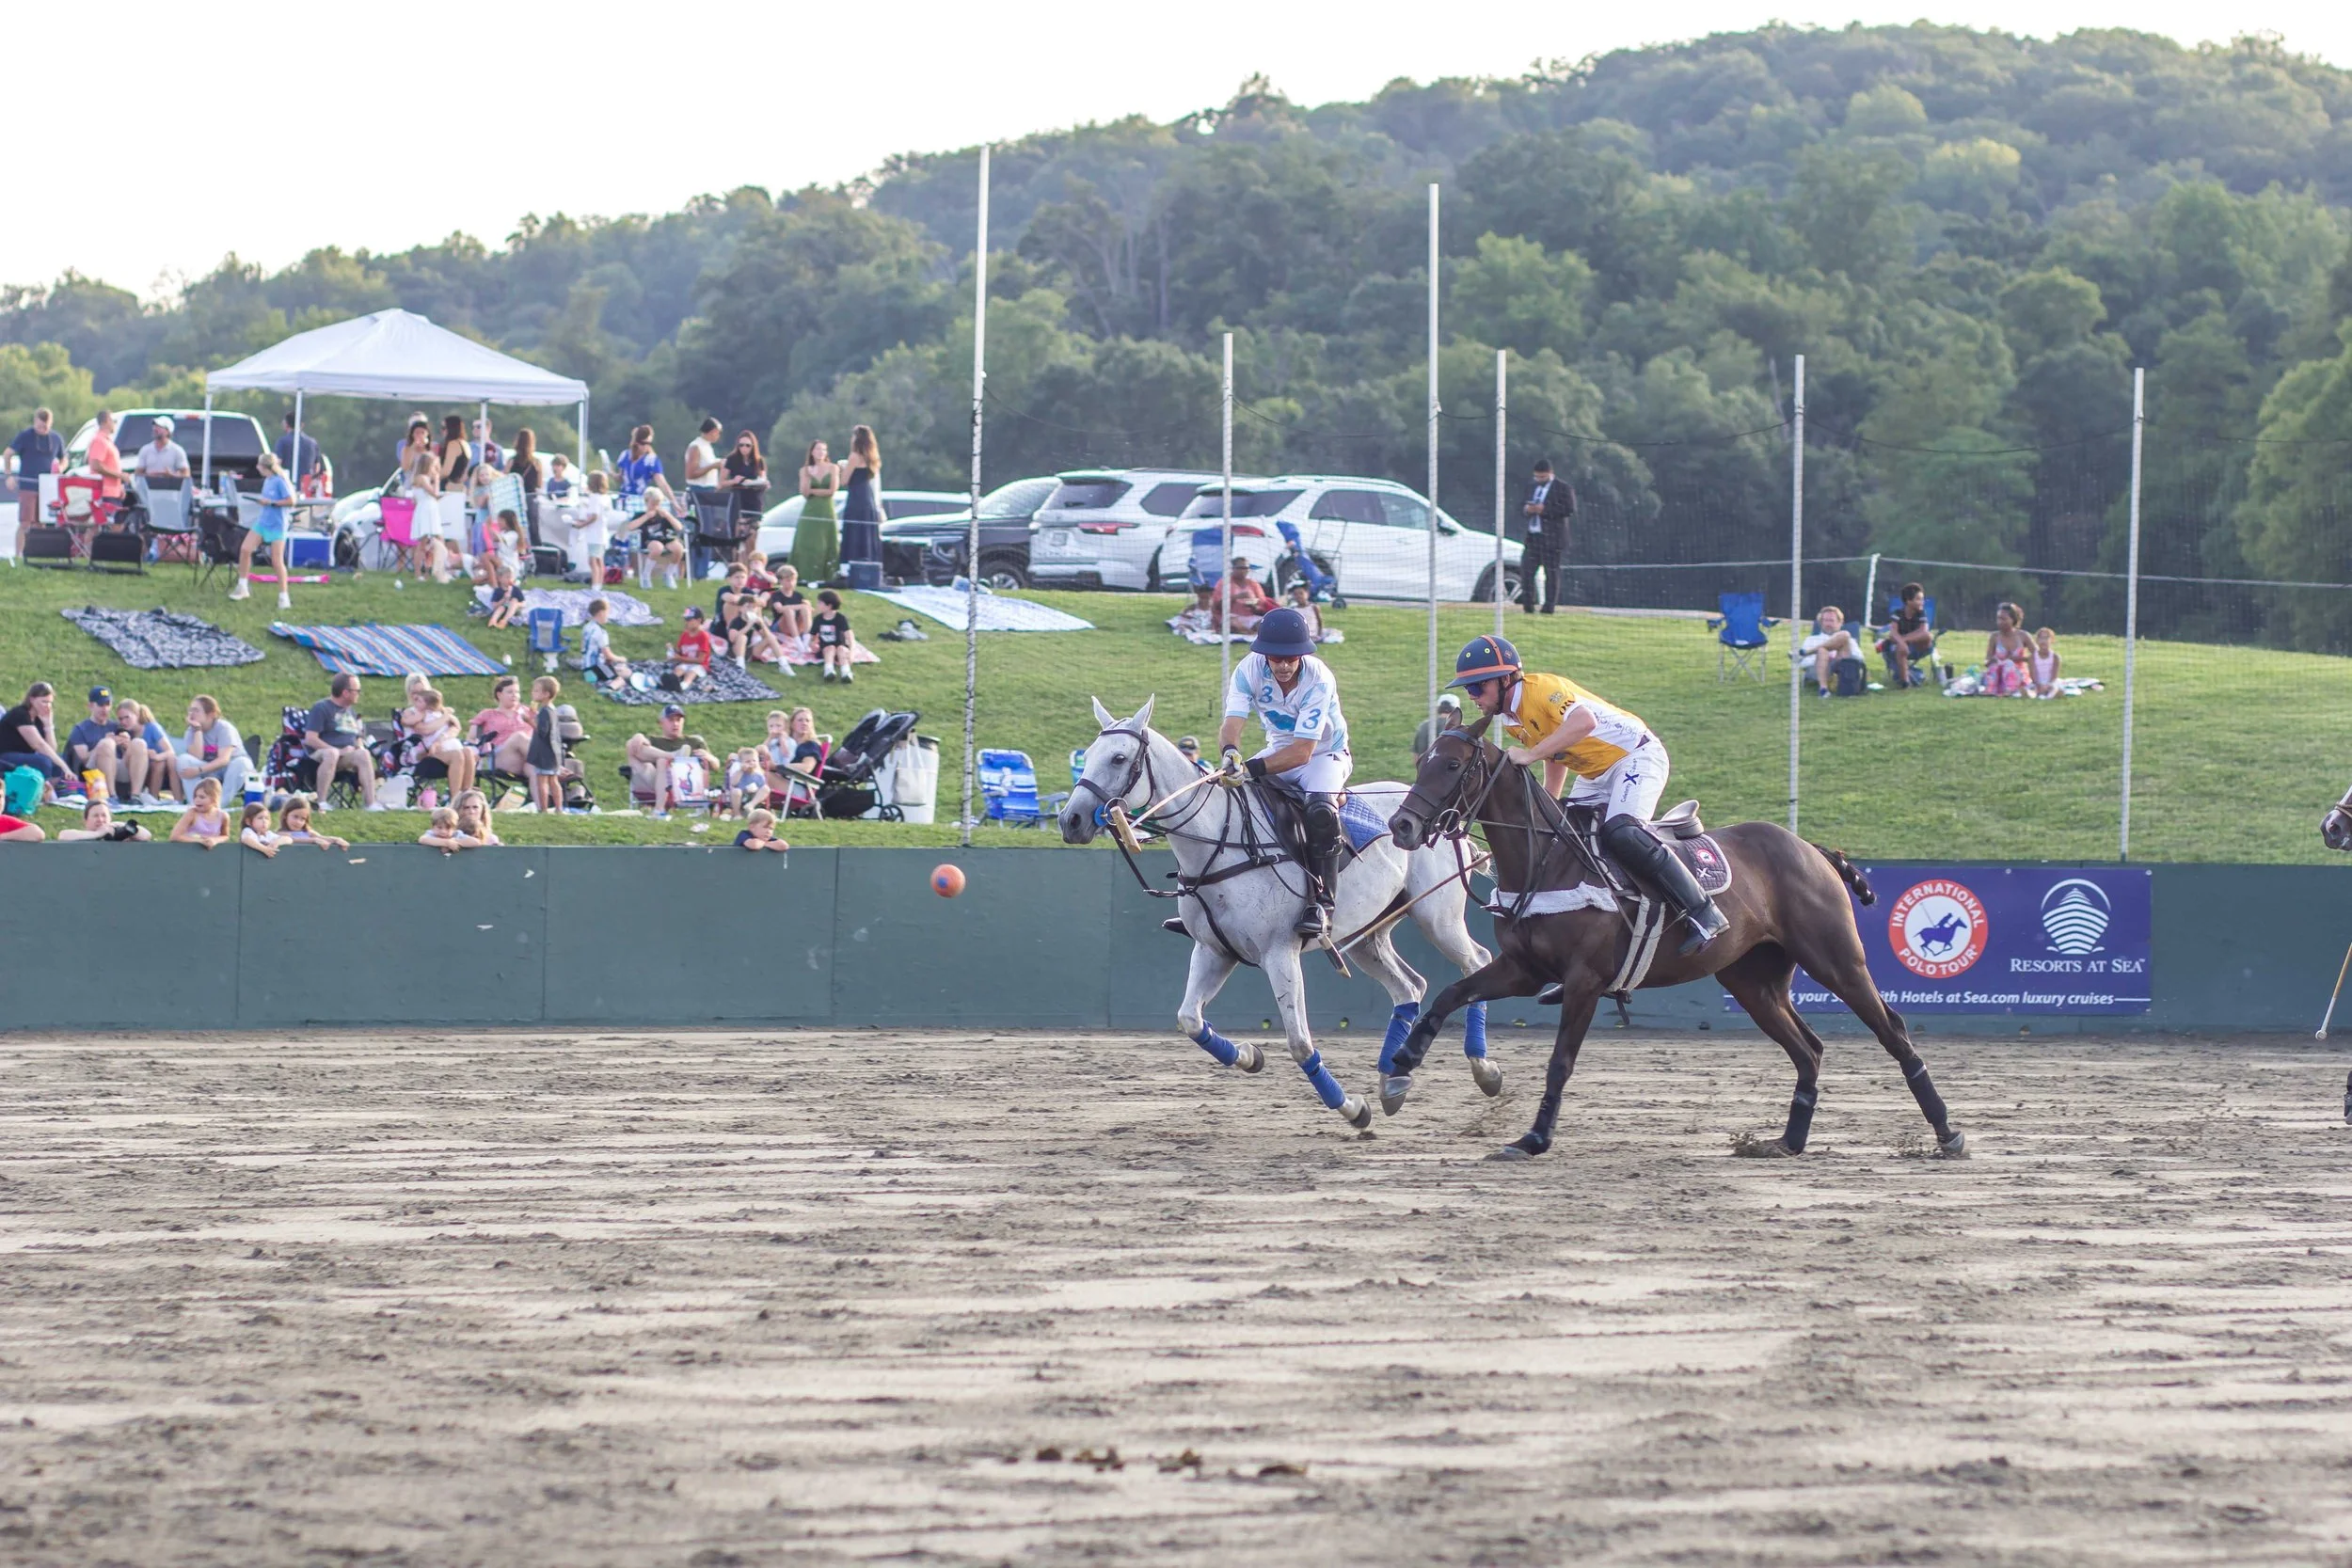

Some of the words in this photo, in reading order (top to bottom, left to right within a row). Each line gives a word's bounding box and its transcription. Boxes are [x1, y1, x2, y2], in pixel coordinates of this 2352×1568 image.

[1259, 686, 1273, 703] 3
[1302, 708, 1321, 729] 3
[1892, 882, 1985, 928] INTERNATIONAL
[1899, 947, 1937, 975] POLO
[2010, 958, 2082, 973] RESORTS
[2087, 960, 2107, 973] AT
[1797, 992, 1830, 1006] your
[1880, 990, 1899, 1003] ith
[1900, 990, 1944, 1003] Hotels
[1946, 990, 1961, 1004] at
[1963, 990, 2019, 1004] Sea.com
[2022, 990, 2065, 1007] luxury
[2067, 991, 2114, 1005] cruises
